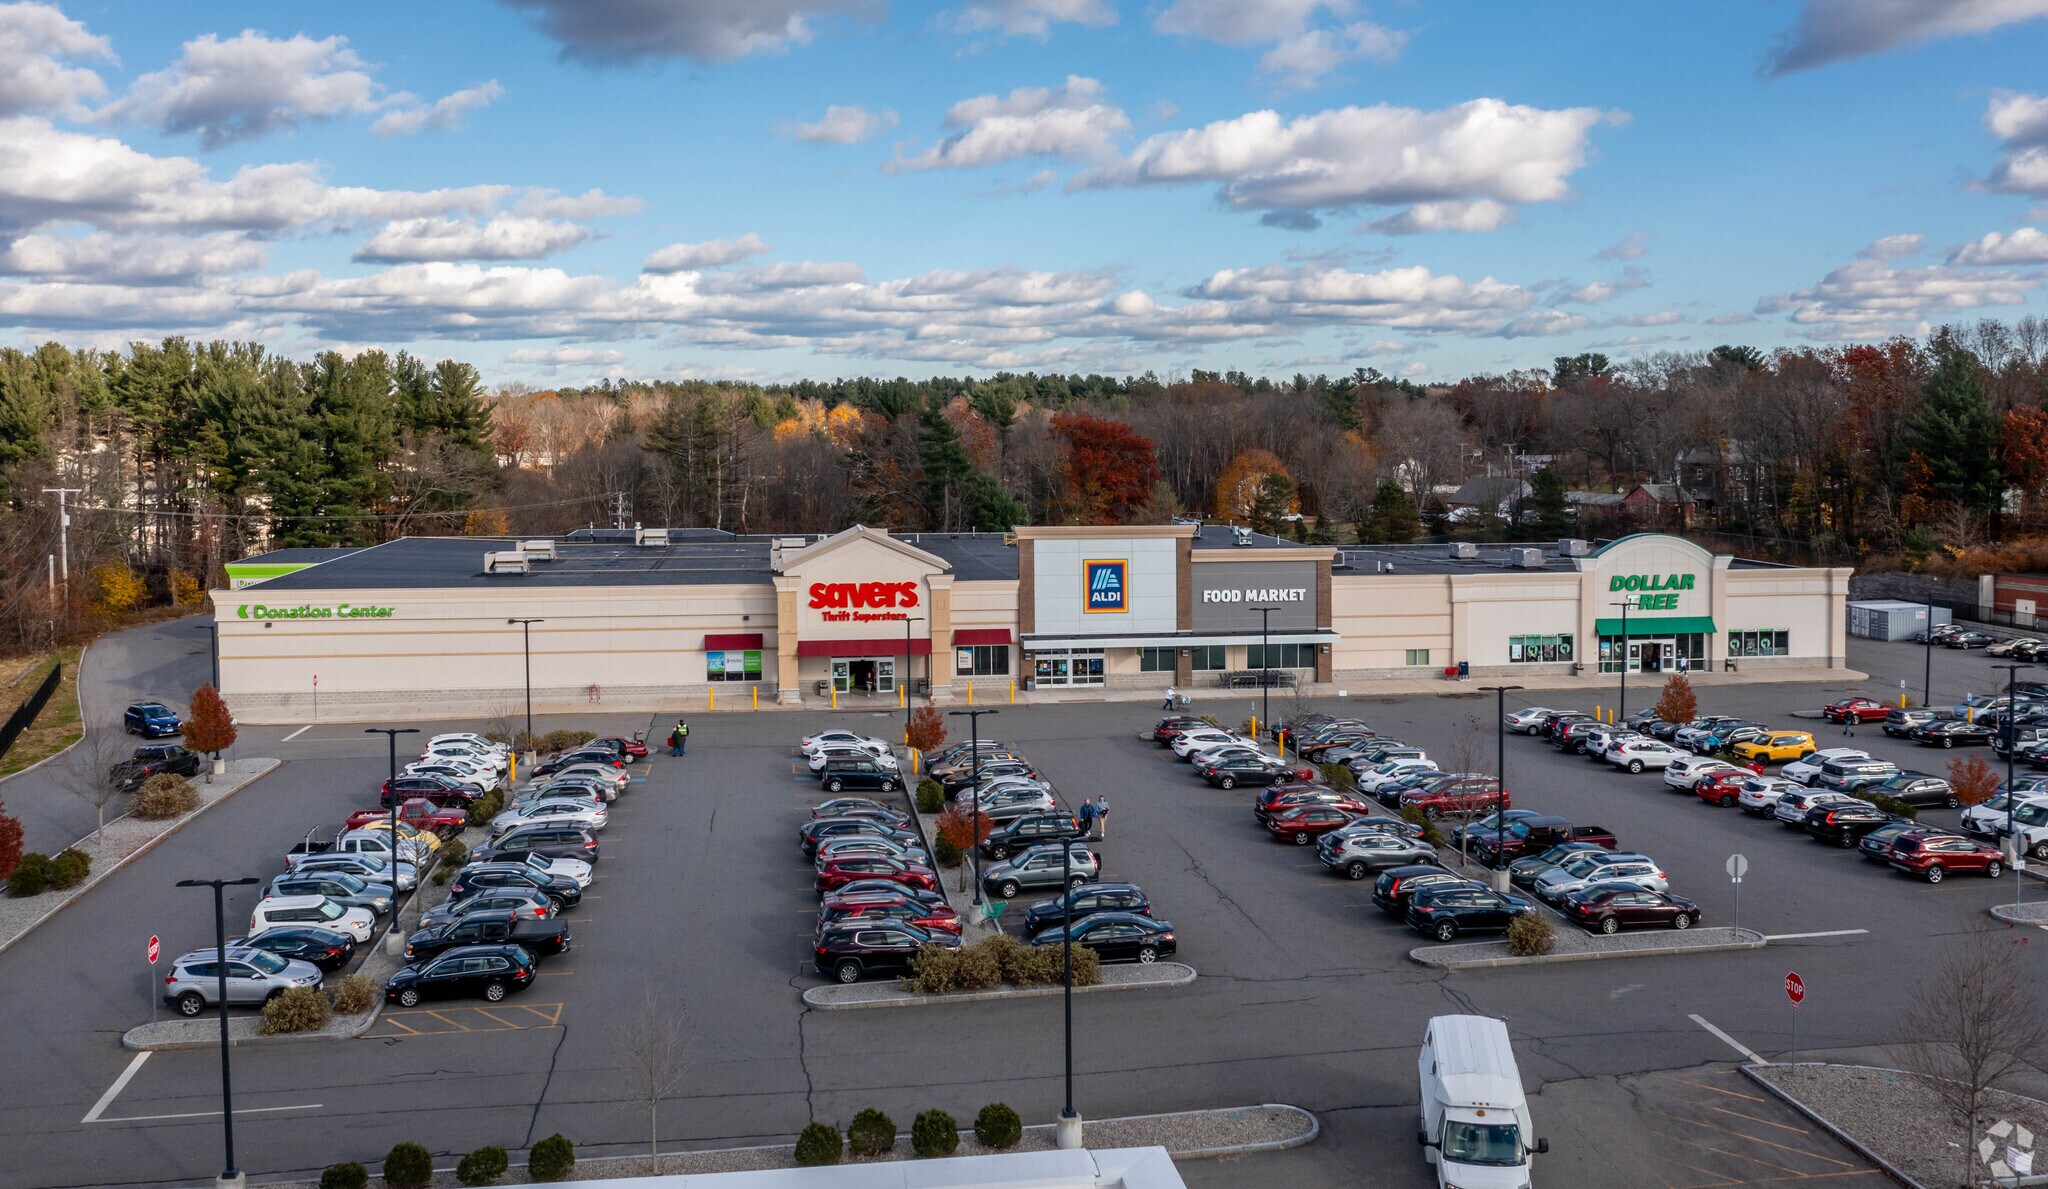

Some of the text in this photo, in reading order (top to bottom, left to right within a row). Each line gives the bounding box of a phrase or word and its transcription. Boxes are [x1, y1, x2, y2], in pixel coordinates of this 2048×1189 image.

[1609, 573, 1695, 592] DOLLAR
[808, 581, 919, 609] savers
[1092, 591, 1121, 602] ALDI
[1203, 588, 1307, 603] FOOD MARKET
[1626, 593, 1679, 610] TREE
[253, 603, 395, 619] Donation Center
[822, 611, 908, 623] Thrift Superstore
[1786, 979, 1803, 995] STOP
